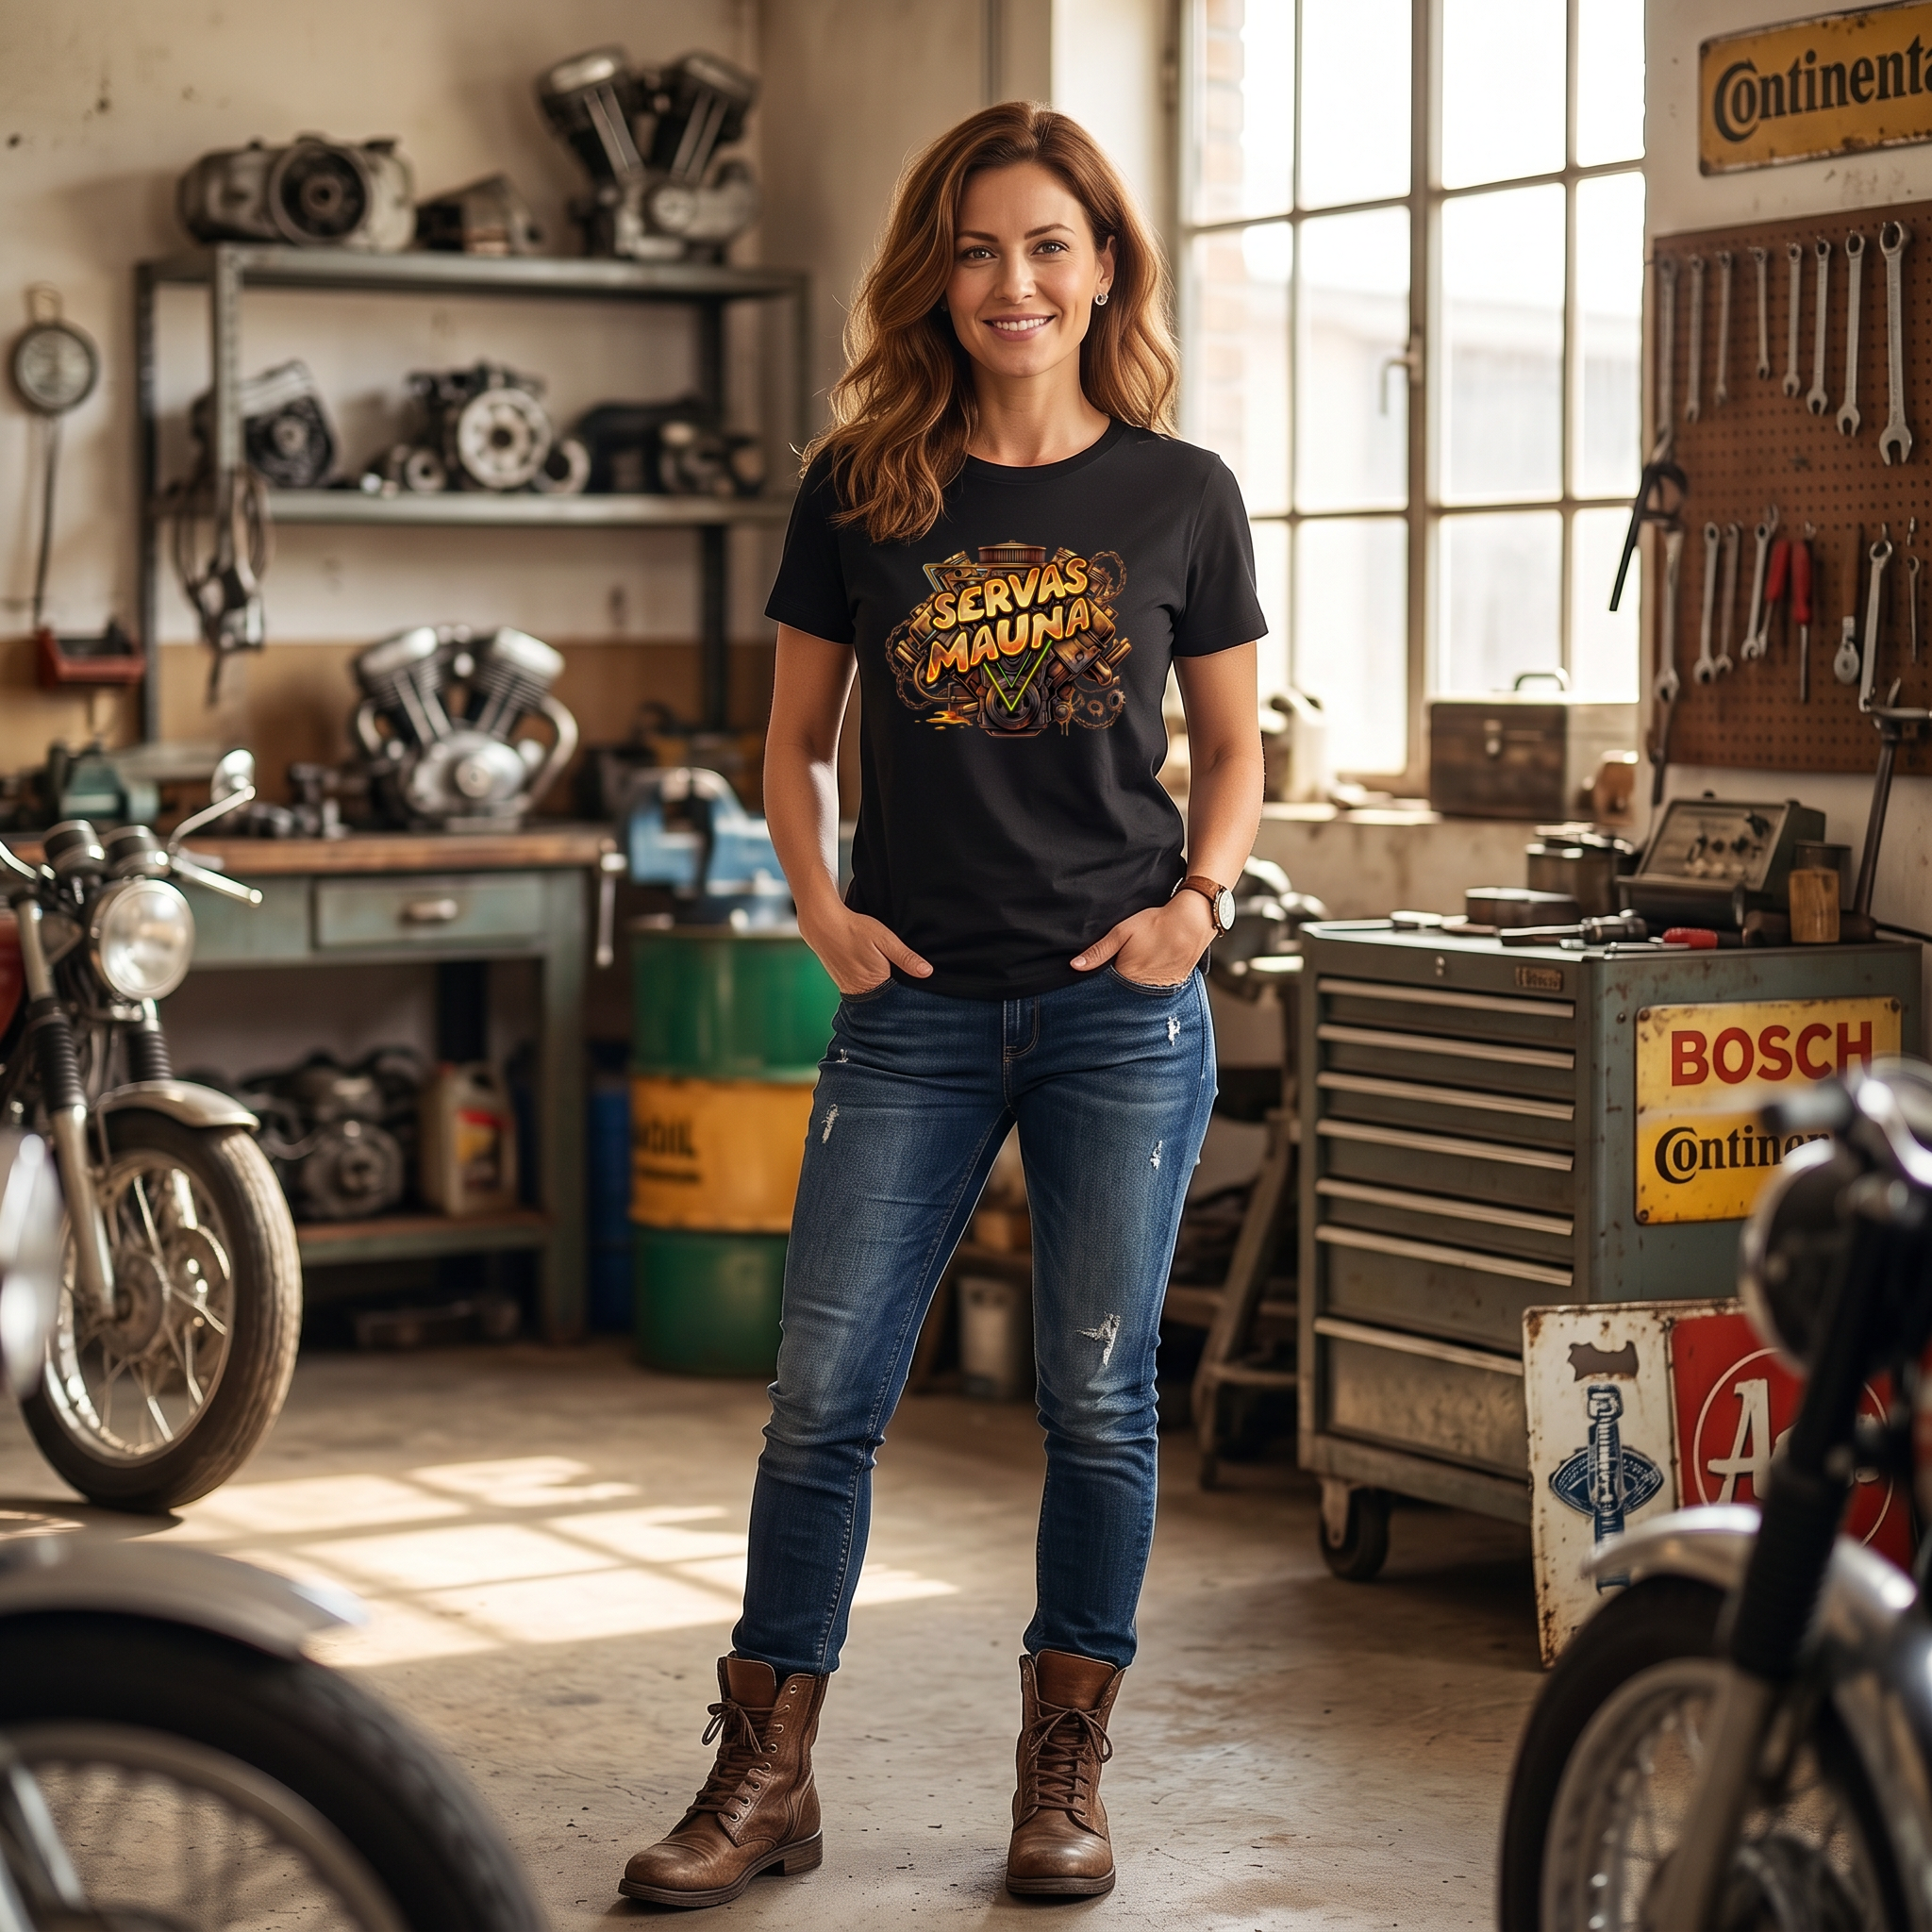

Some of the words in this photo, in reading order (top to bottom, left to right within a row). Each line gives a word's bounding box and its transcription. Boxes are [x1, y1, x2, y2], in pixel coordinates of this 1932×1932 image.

[932, 558, 1088, 629] SERVAS
[925, 597, 1090, 684] MAUNA
[1672, 1022, 1873, 1086] BOSCH
